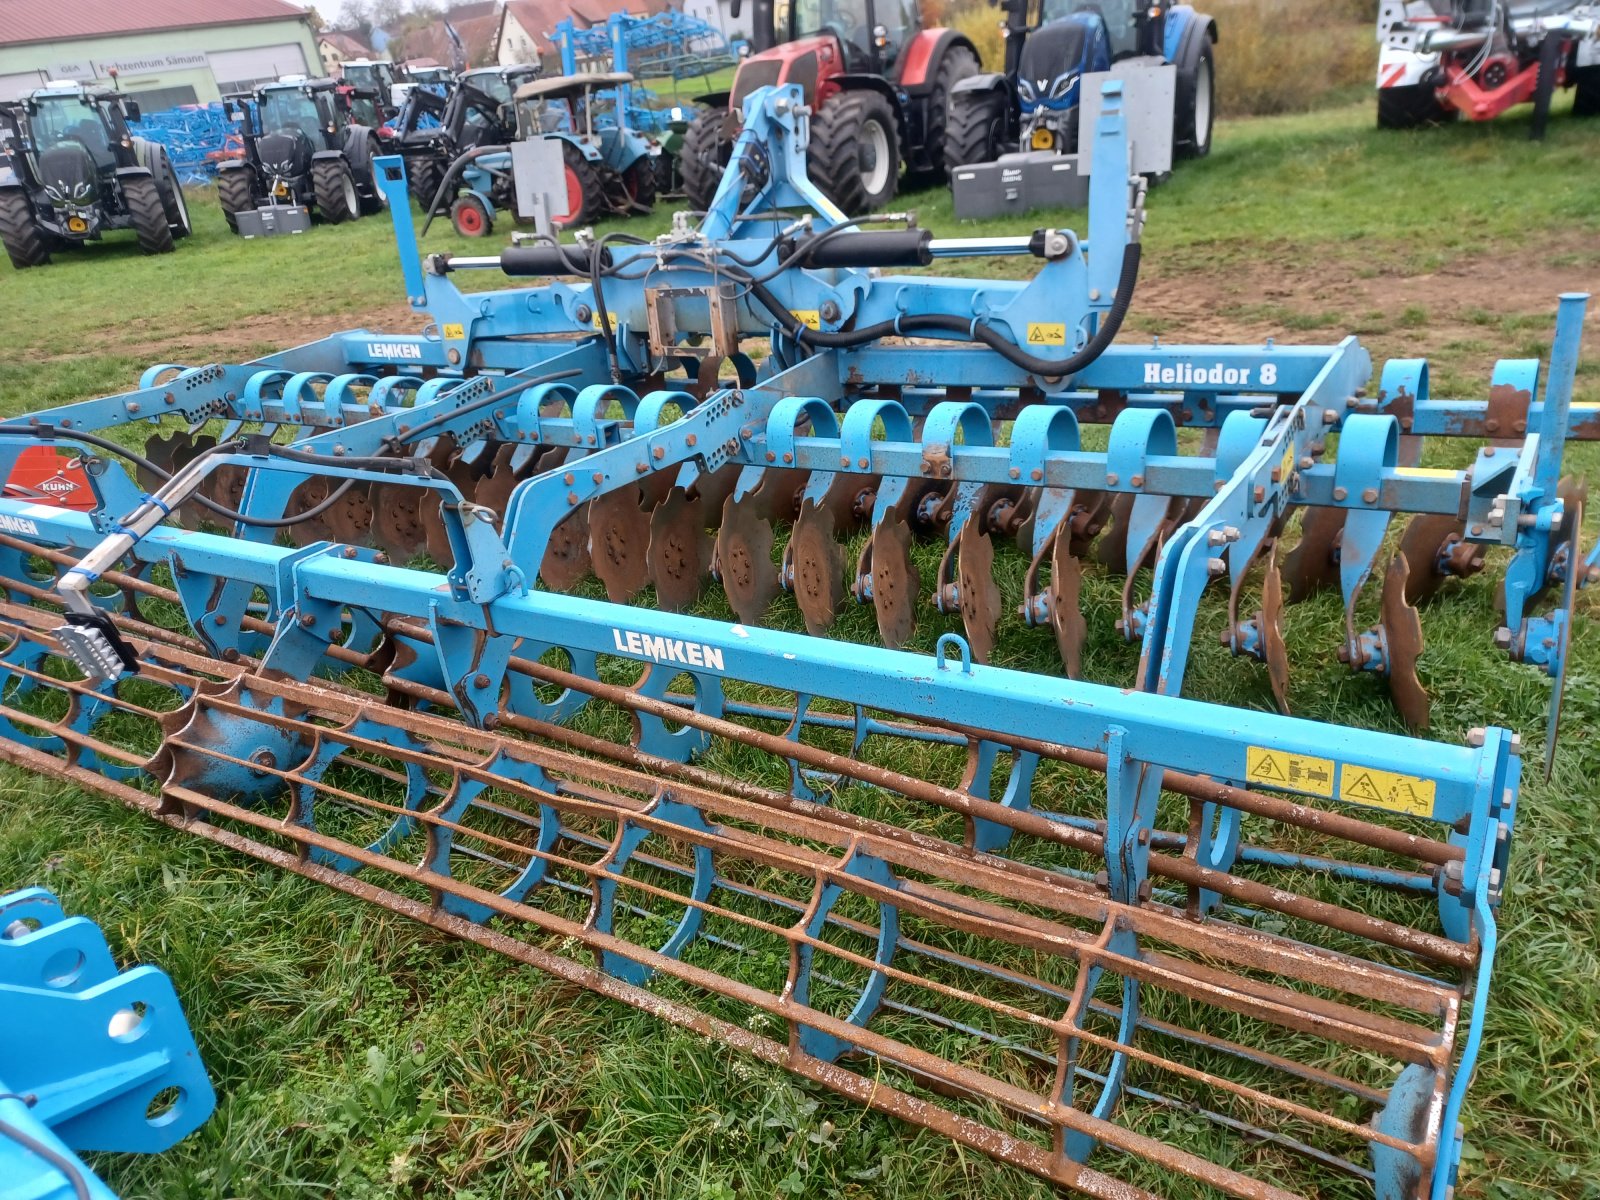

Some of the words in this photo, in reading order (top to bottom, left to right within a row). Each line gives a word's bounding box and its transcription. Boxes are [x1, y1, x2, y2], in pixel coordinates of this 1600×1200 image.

[165, 54, 205, 66] Sämann
[367, 343, 422, 360] LEMKEN
[1143, 362, 1251, 385] Heliodor
[1259, 362, 1278, 386] 8
[42, 483, 74, 491] KUHN
[0, 514, 39, 535] EMKEN
[612, 628, 725, 671] LEMKEN
